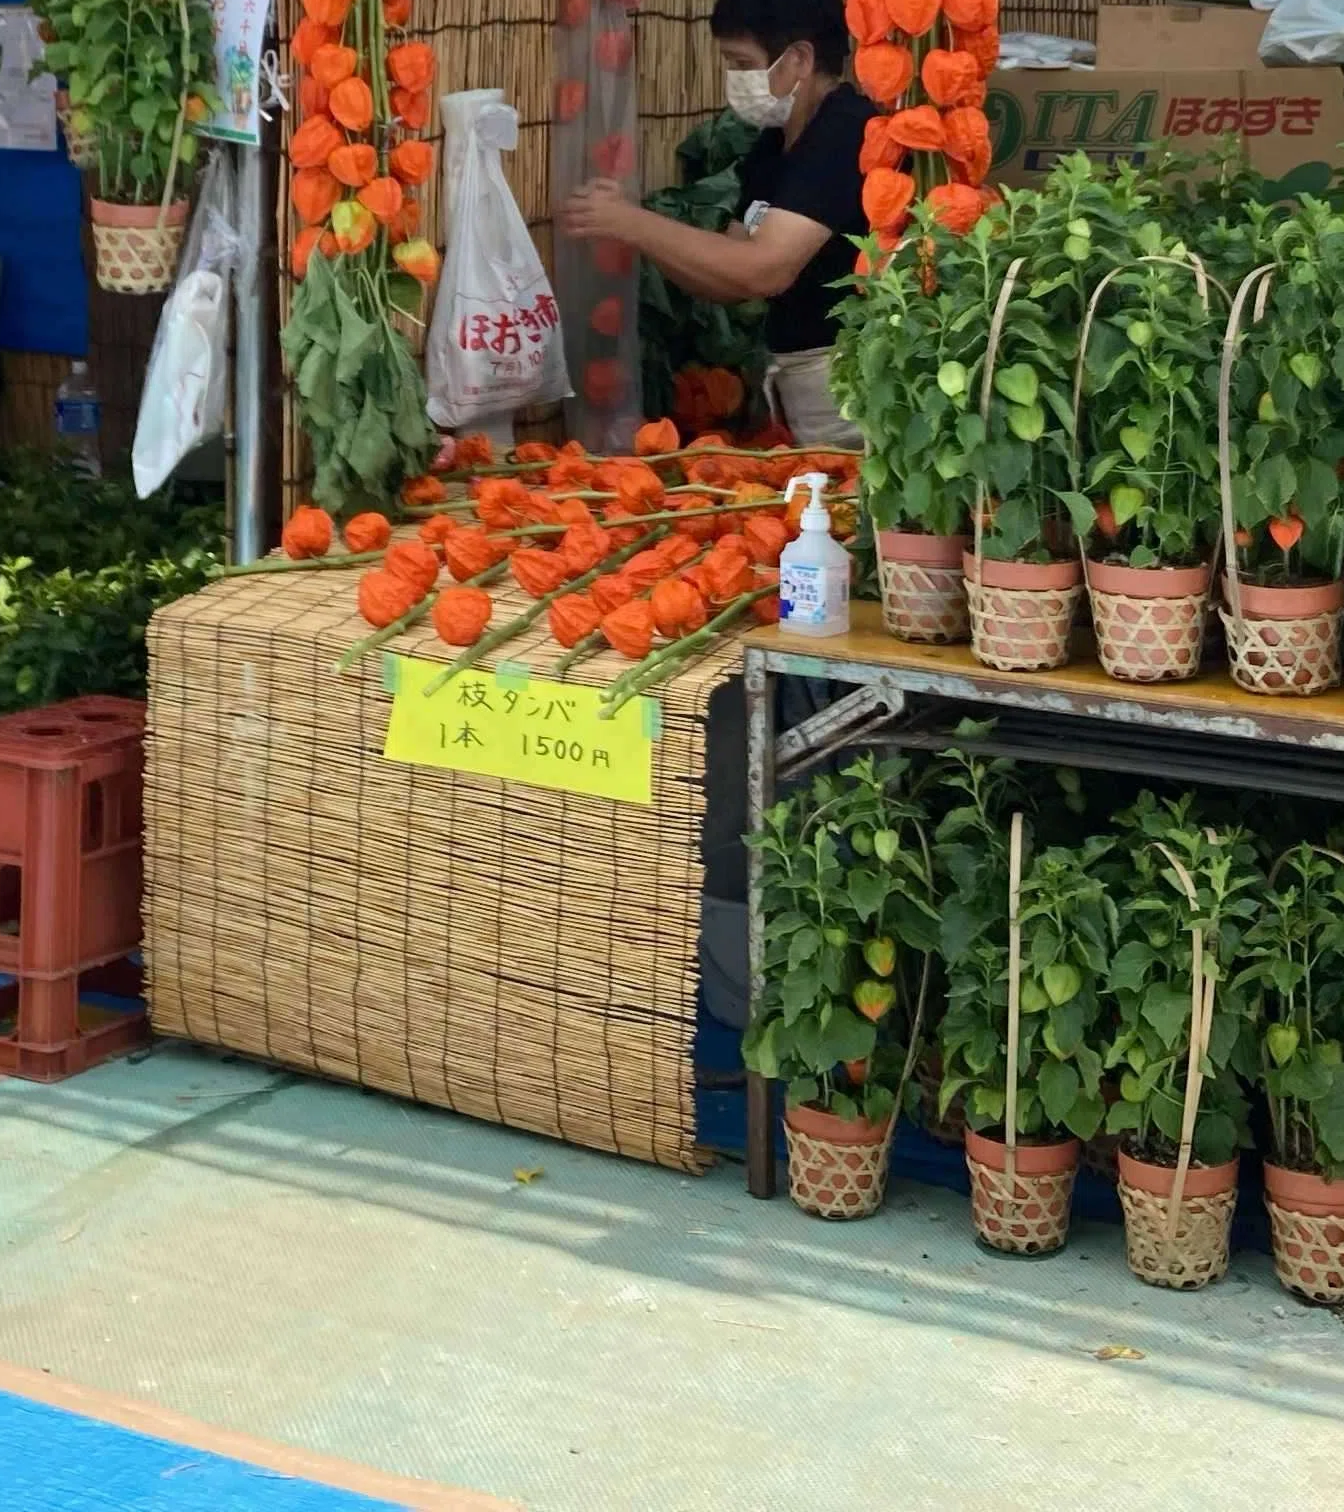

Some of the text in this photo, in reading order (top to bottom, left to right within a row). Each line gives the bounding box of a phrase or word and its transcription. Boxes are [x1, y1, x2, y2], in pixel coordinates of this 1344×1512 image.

[1163, 96, 1323, 137] ほおずき
[457, 681, 577, 723] 枝タンバ
[439, 720, 611, 769] 1本 1500円
